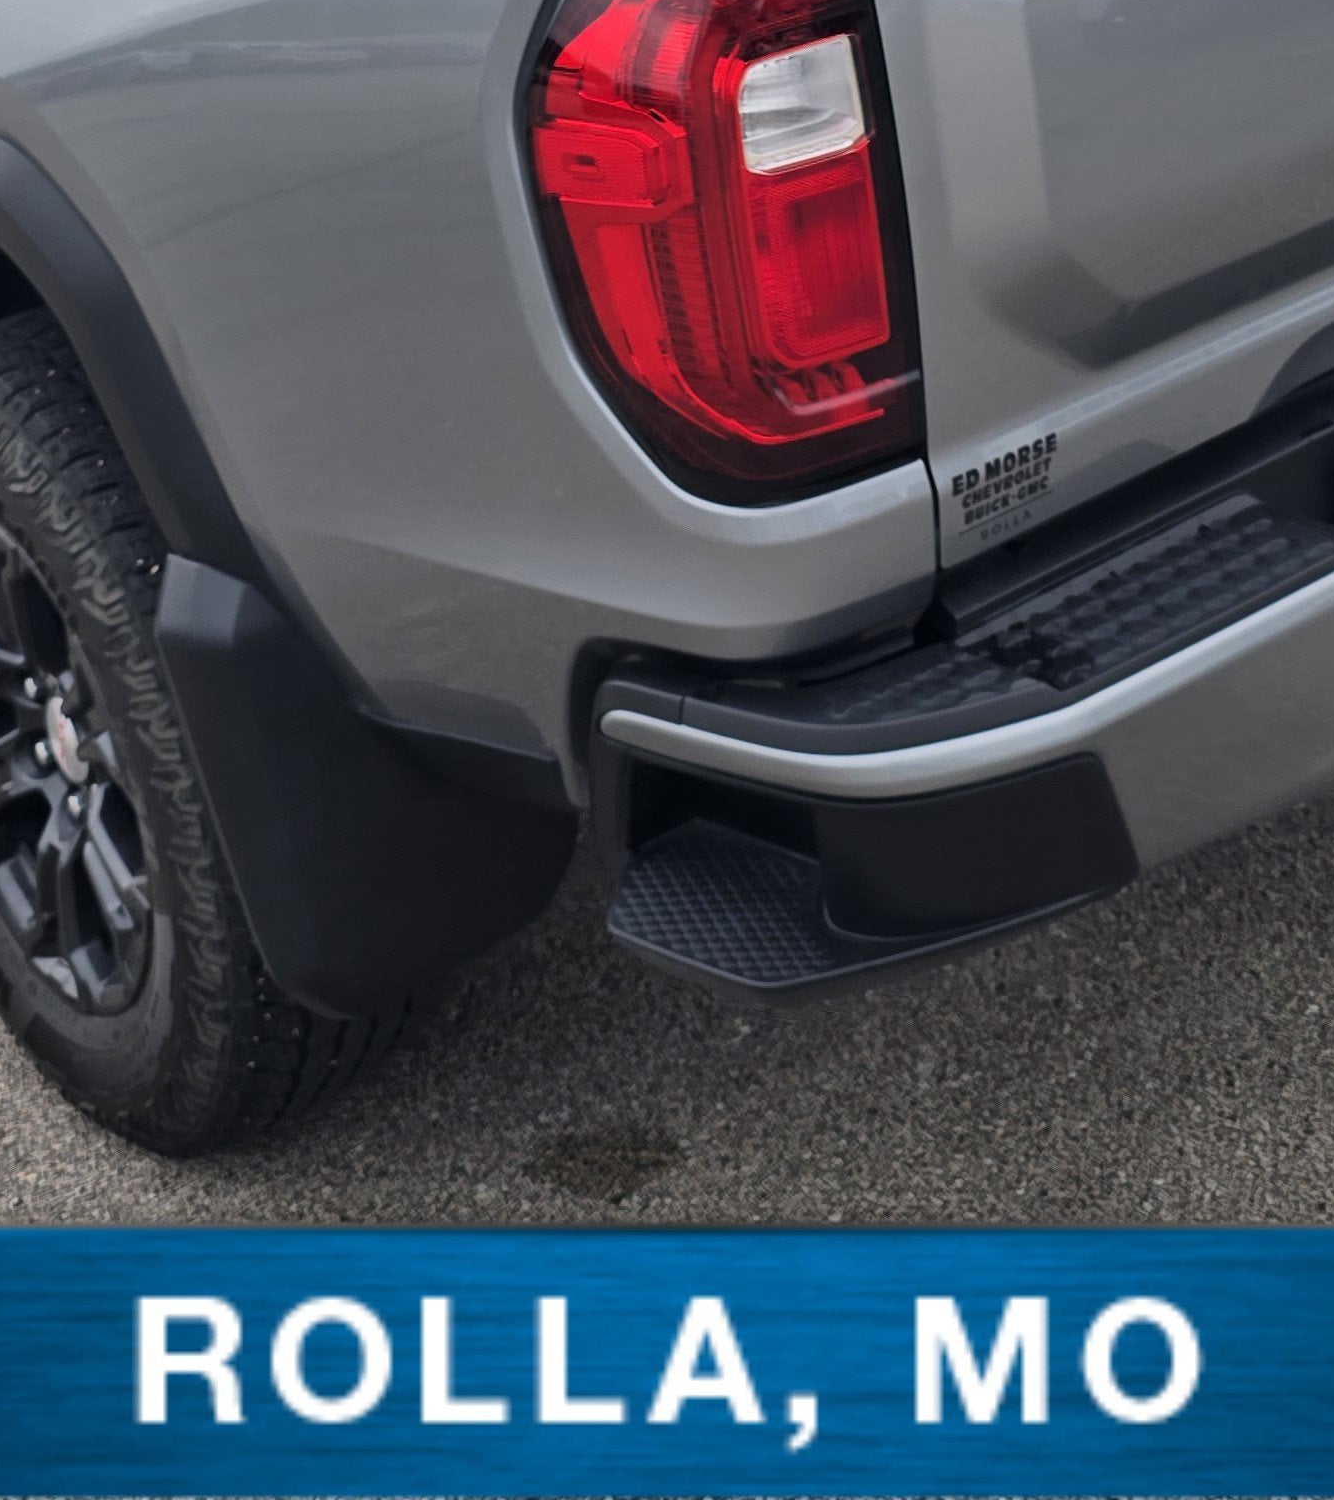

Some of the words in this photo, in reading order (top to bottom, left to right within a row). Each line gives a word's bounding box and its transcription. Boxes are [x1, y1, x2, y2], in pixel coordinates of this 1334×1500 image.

[952, 467, 980, 497] ED
[984, 432, 1058, 482] MORSE
[961, 456, 1053, 509] CHEVROLET
